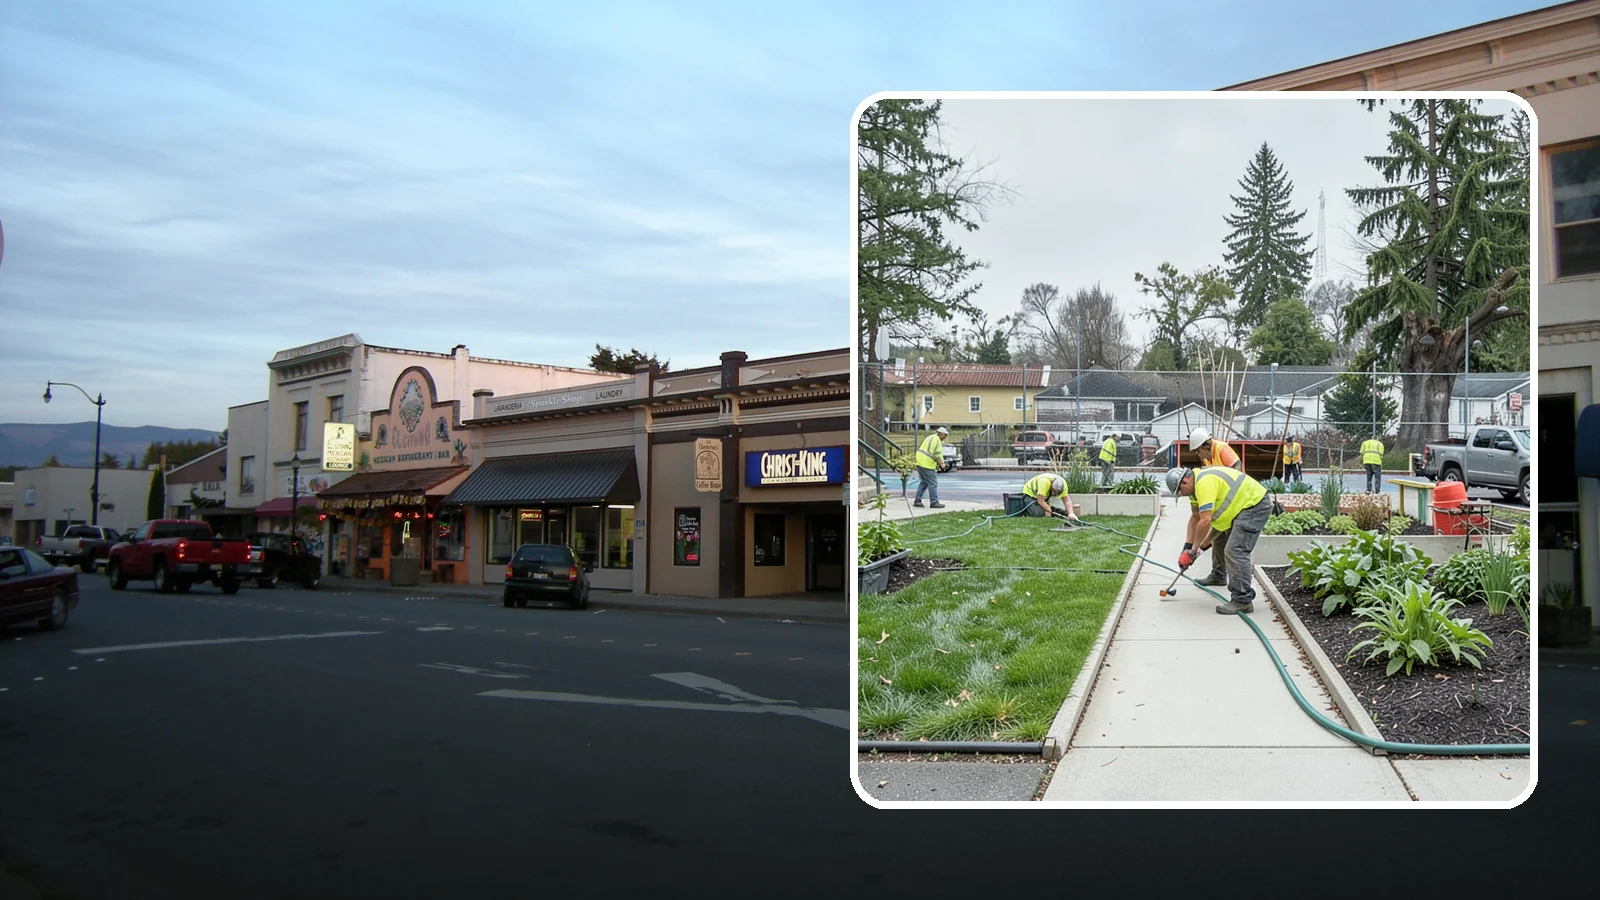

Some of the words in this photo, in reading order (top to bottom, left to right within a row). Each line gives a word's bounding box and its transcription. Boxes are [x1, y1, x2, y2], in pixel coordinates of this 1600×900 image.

[493, 402, 522, 412] LAVANDERIA
[561, 395, 582, 405] Shop
[595, 389, 624, 400] LAUNDRY
[373, 455, 396, 465] MEXICAN
[397, 451, 433, 462] RESTAURANT
[437, 450, 450, 459] BAR
[761, 452, 797, 477] CHRIST
[799, 450, 827, 476] KING
